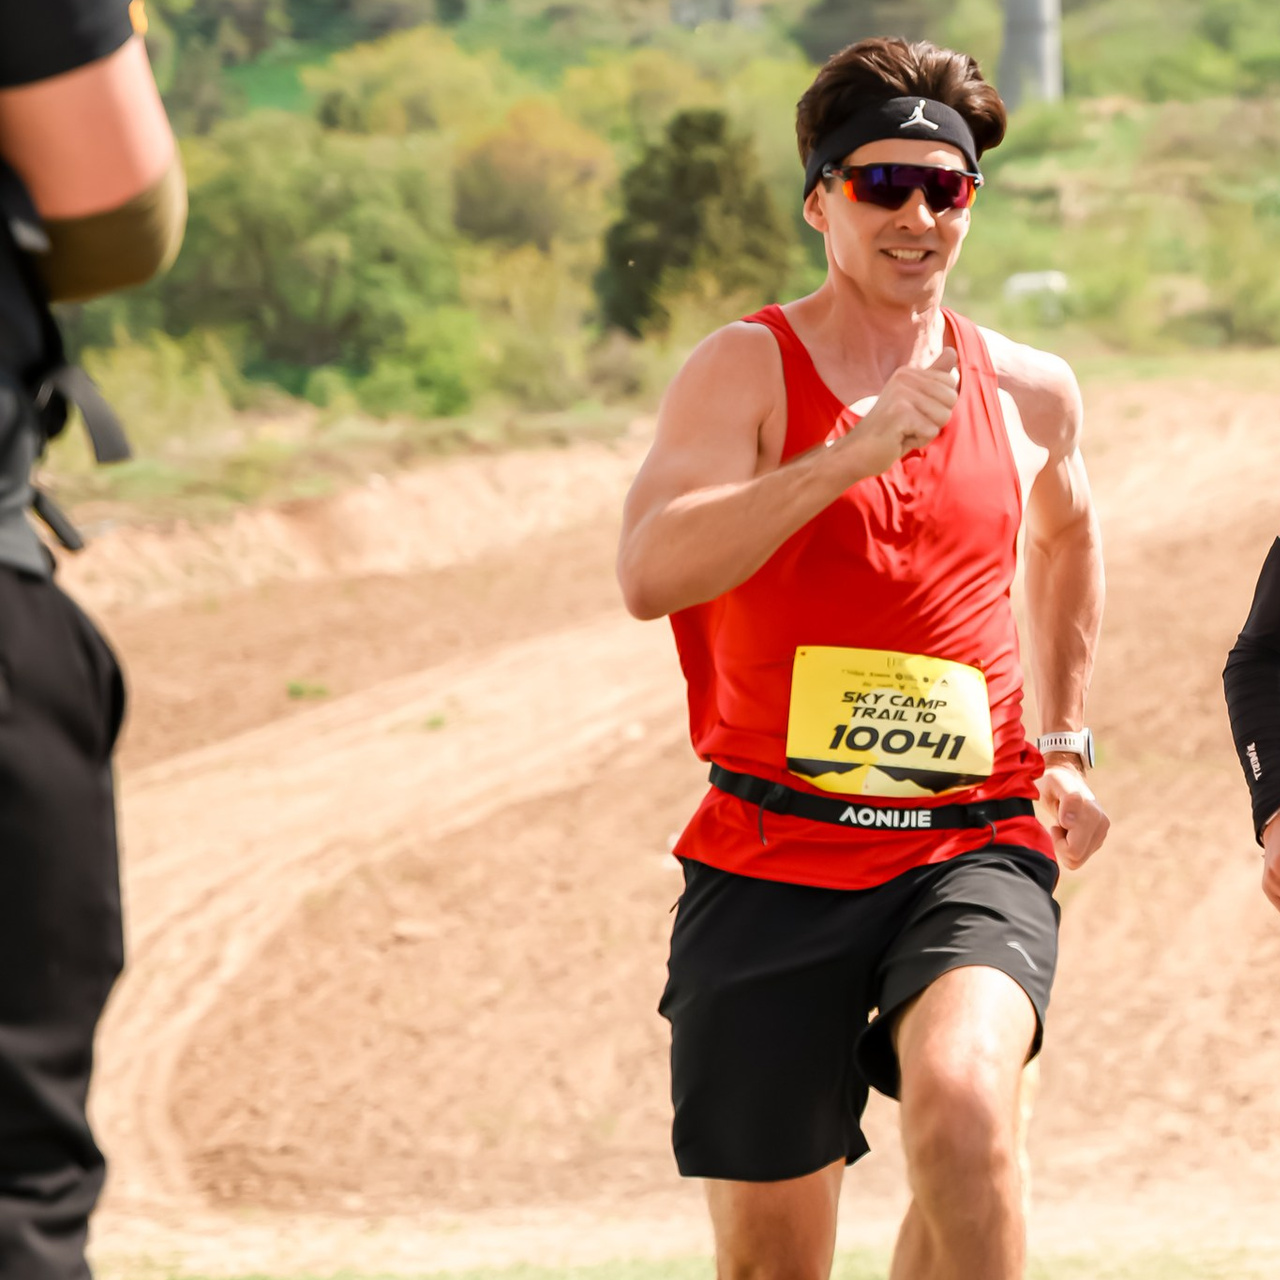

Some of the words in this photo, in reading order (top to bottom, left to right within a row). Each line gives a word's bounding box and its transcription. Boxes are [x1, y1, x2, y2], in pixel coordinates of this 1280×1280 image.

[841, 690, 885, 705] SKY
[889, 694, 948, 711] CAMP
[850, 705, 909, 722] TRAIL
[915, 710, 937, 725] 10
[828, 724, 967, 761] 10041
[838, 804, 932, 829] AONIJIE
